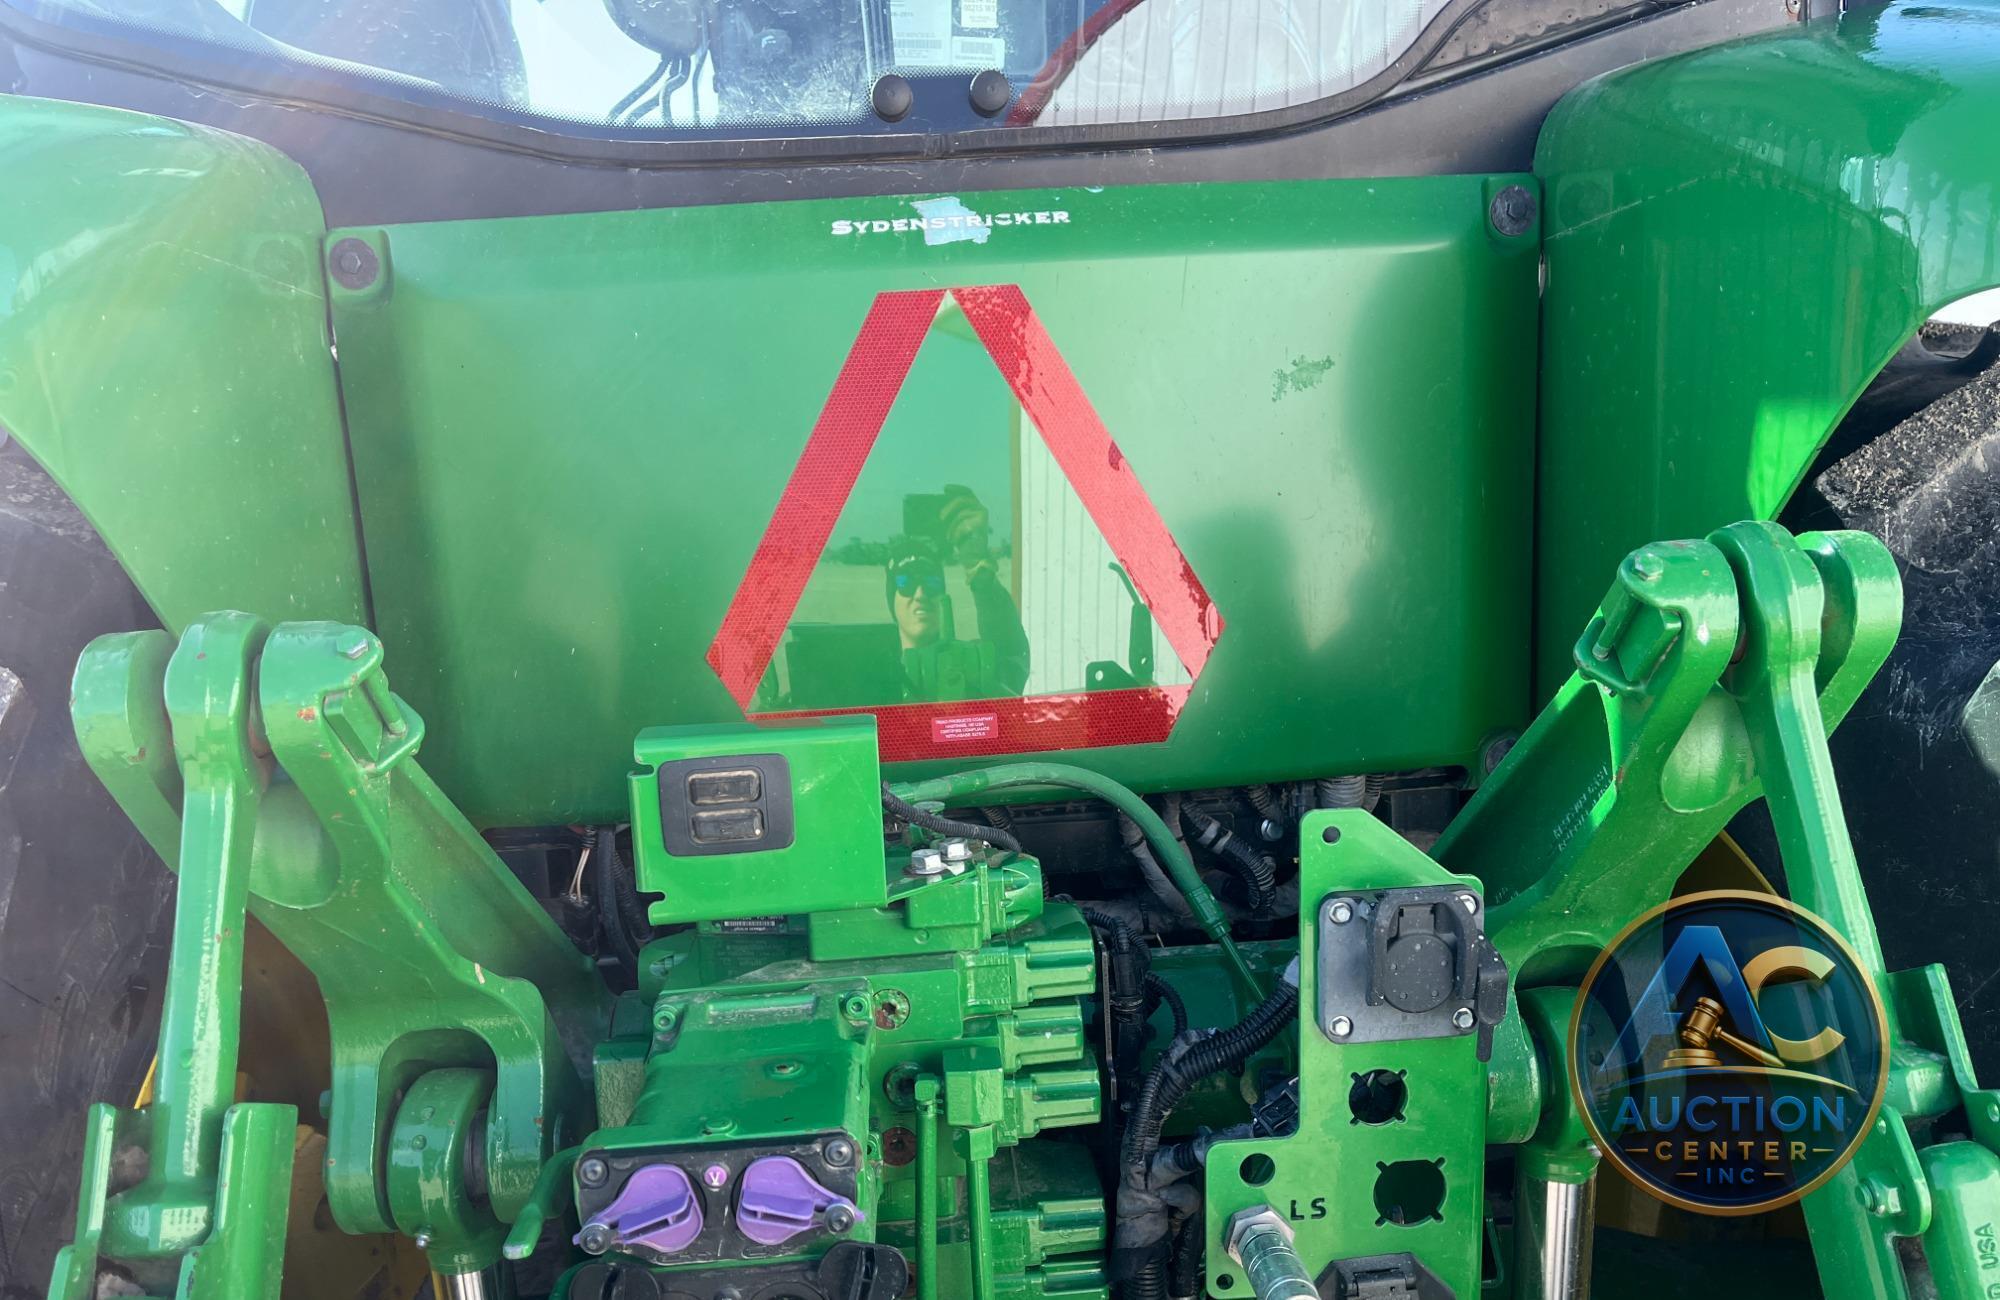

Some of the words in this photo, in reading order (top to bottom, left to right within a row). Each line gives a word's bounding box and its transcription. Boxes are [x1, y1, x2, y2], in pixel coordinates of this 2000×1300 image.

[831, 210, 1071, 235] SYDENSTRICKER
[1290, 1197, 1327, 1221] LS
[1974, 1222, 1999, 1270] USA
